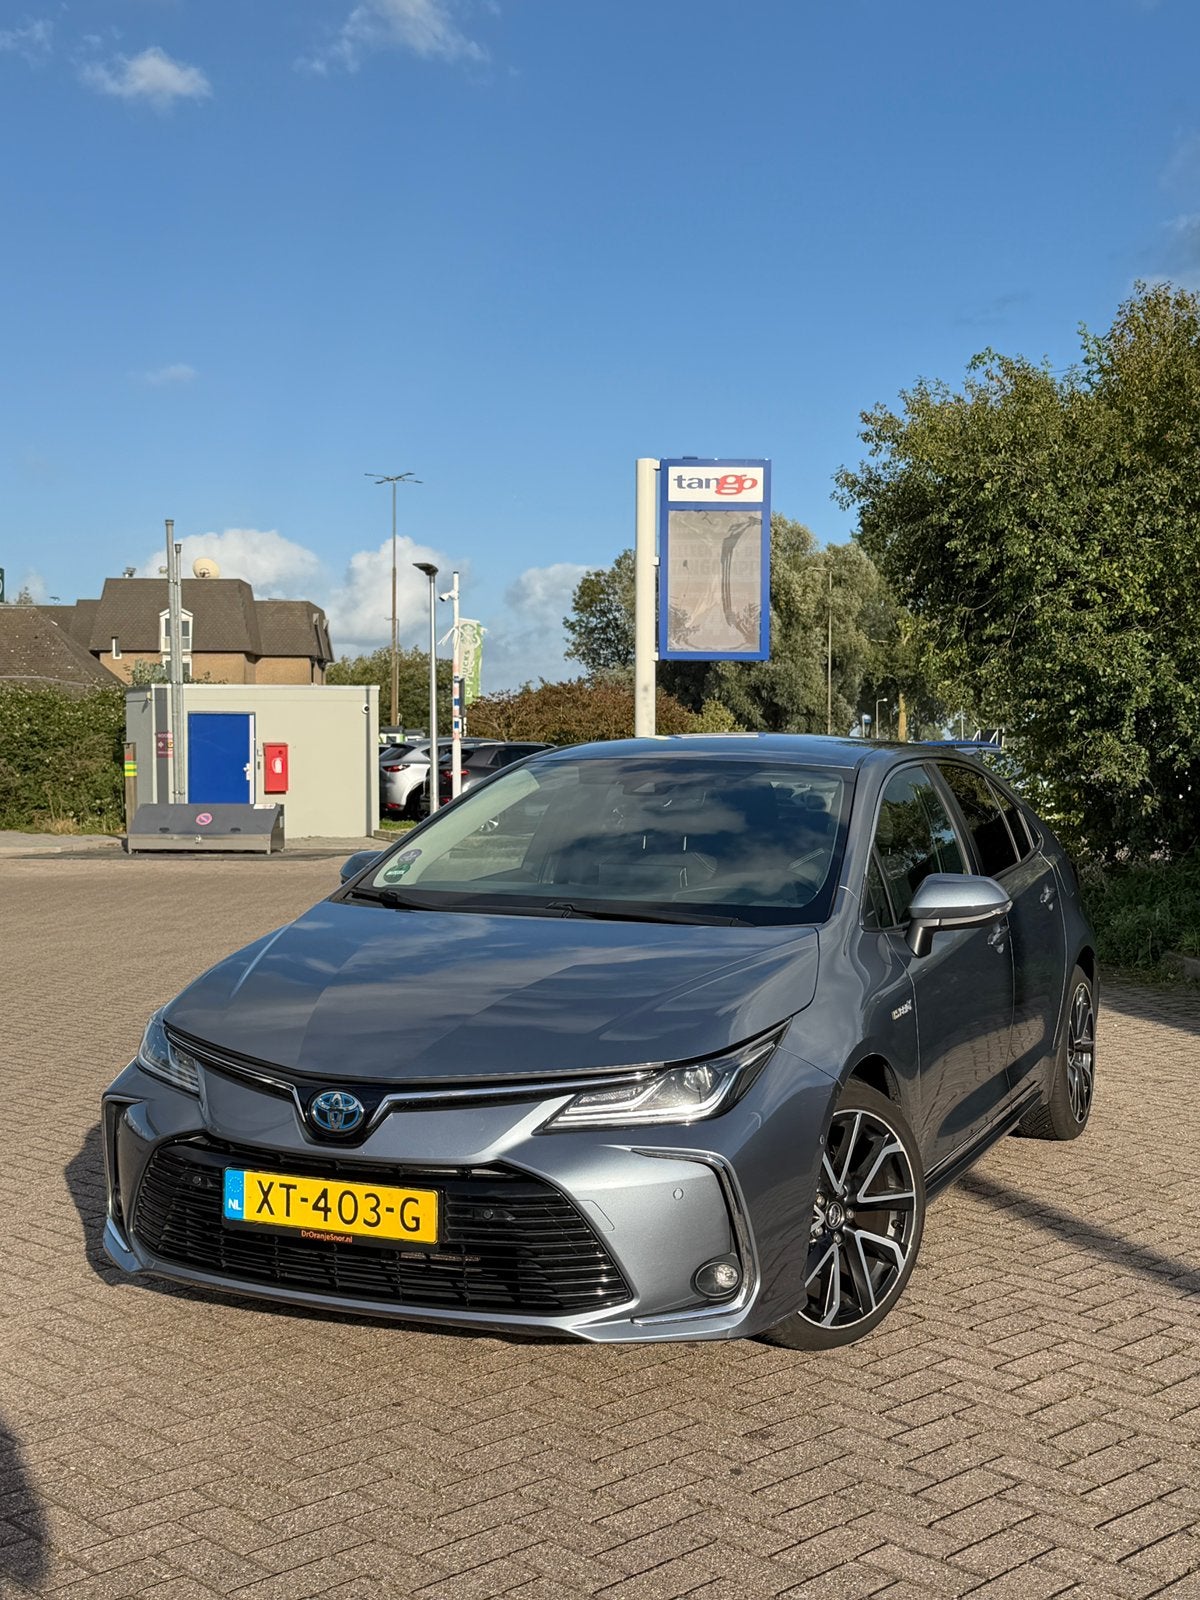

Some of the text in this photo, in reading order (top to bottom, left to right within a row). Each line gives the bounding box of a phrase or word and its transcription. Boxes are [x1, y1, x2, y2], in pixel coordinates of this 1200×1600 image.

[673, 474, 758, 496] tango
[228, 1198, 242, 1211] NL
[256, 1179, 421, 1233] XT-403-G
[301, 1229, 353, 1244] DrOranjeSnor.nl
